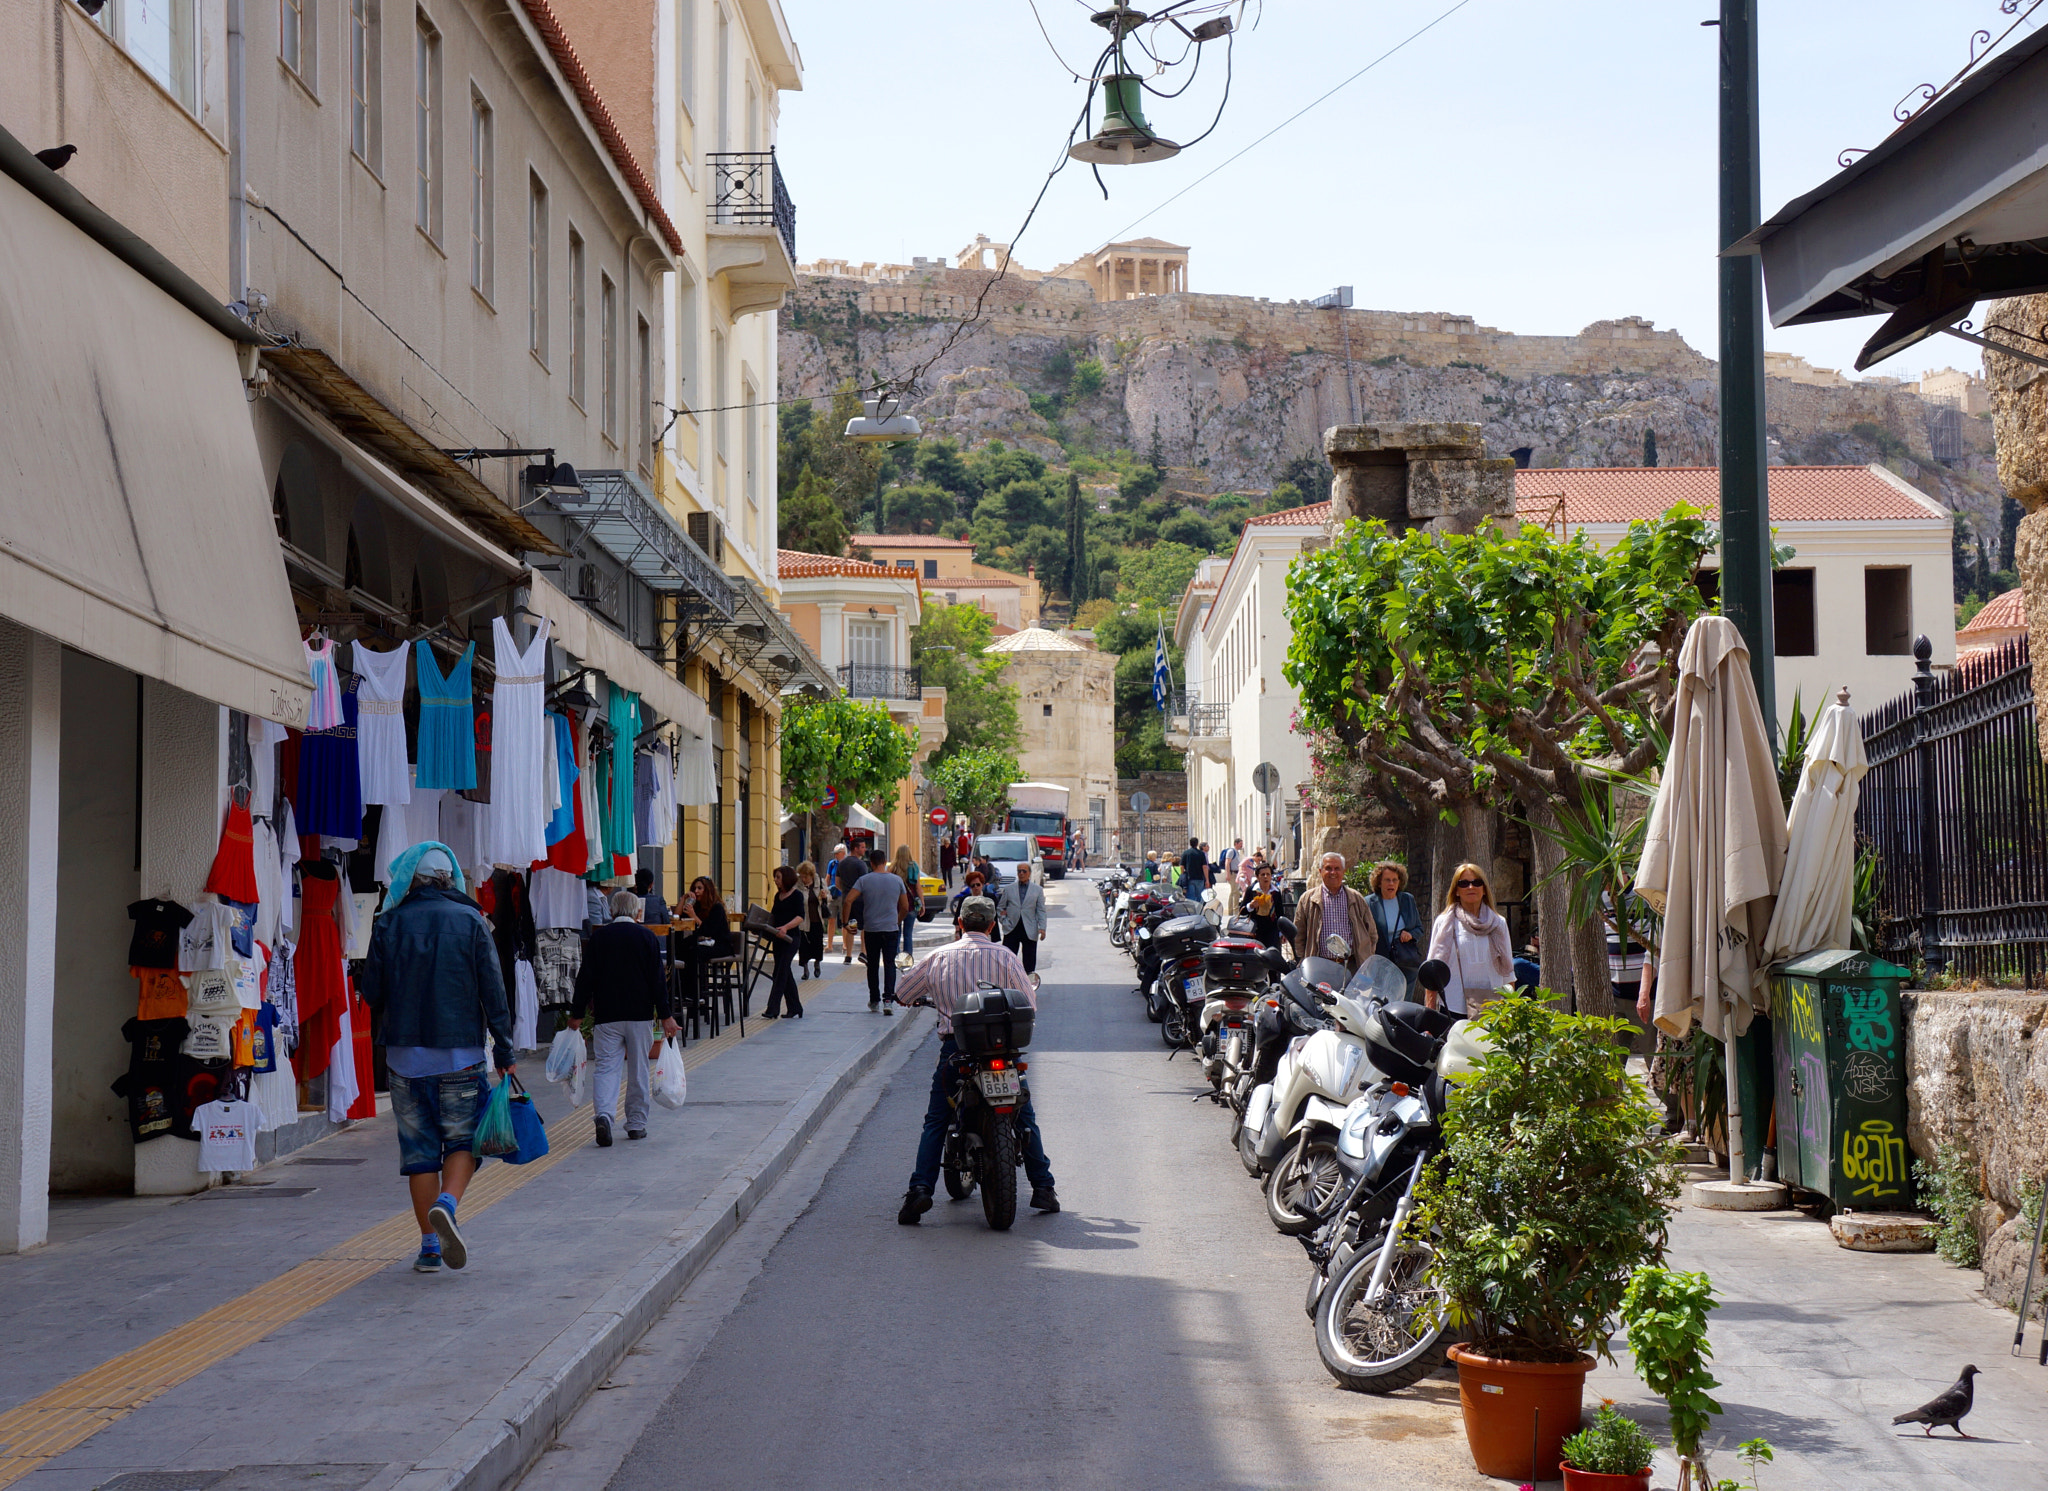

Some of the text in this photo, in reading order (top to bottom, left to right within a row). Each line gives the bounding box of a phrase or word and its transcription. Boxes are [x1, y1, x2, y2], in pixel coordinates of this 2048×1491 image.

[193, 1023, 220, 1035] ATHENS
[986, 1082, 1009, 1095] 868
[1842, 1129, 1906, 1183] bean
